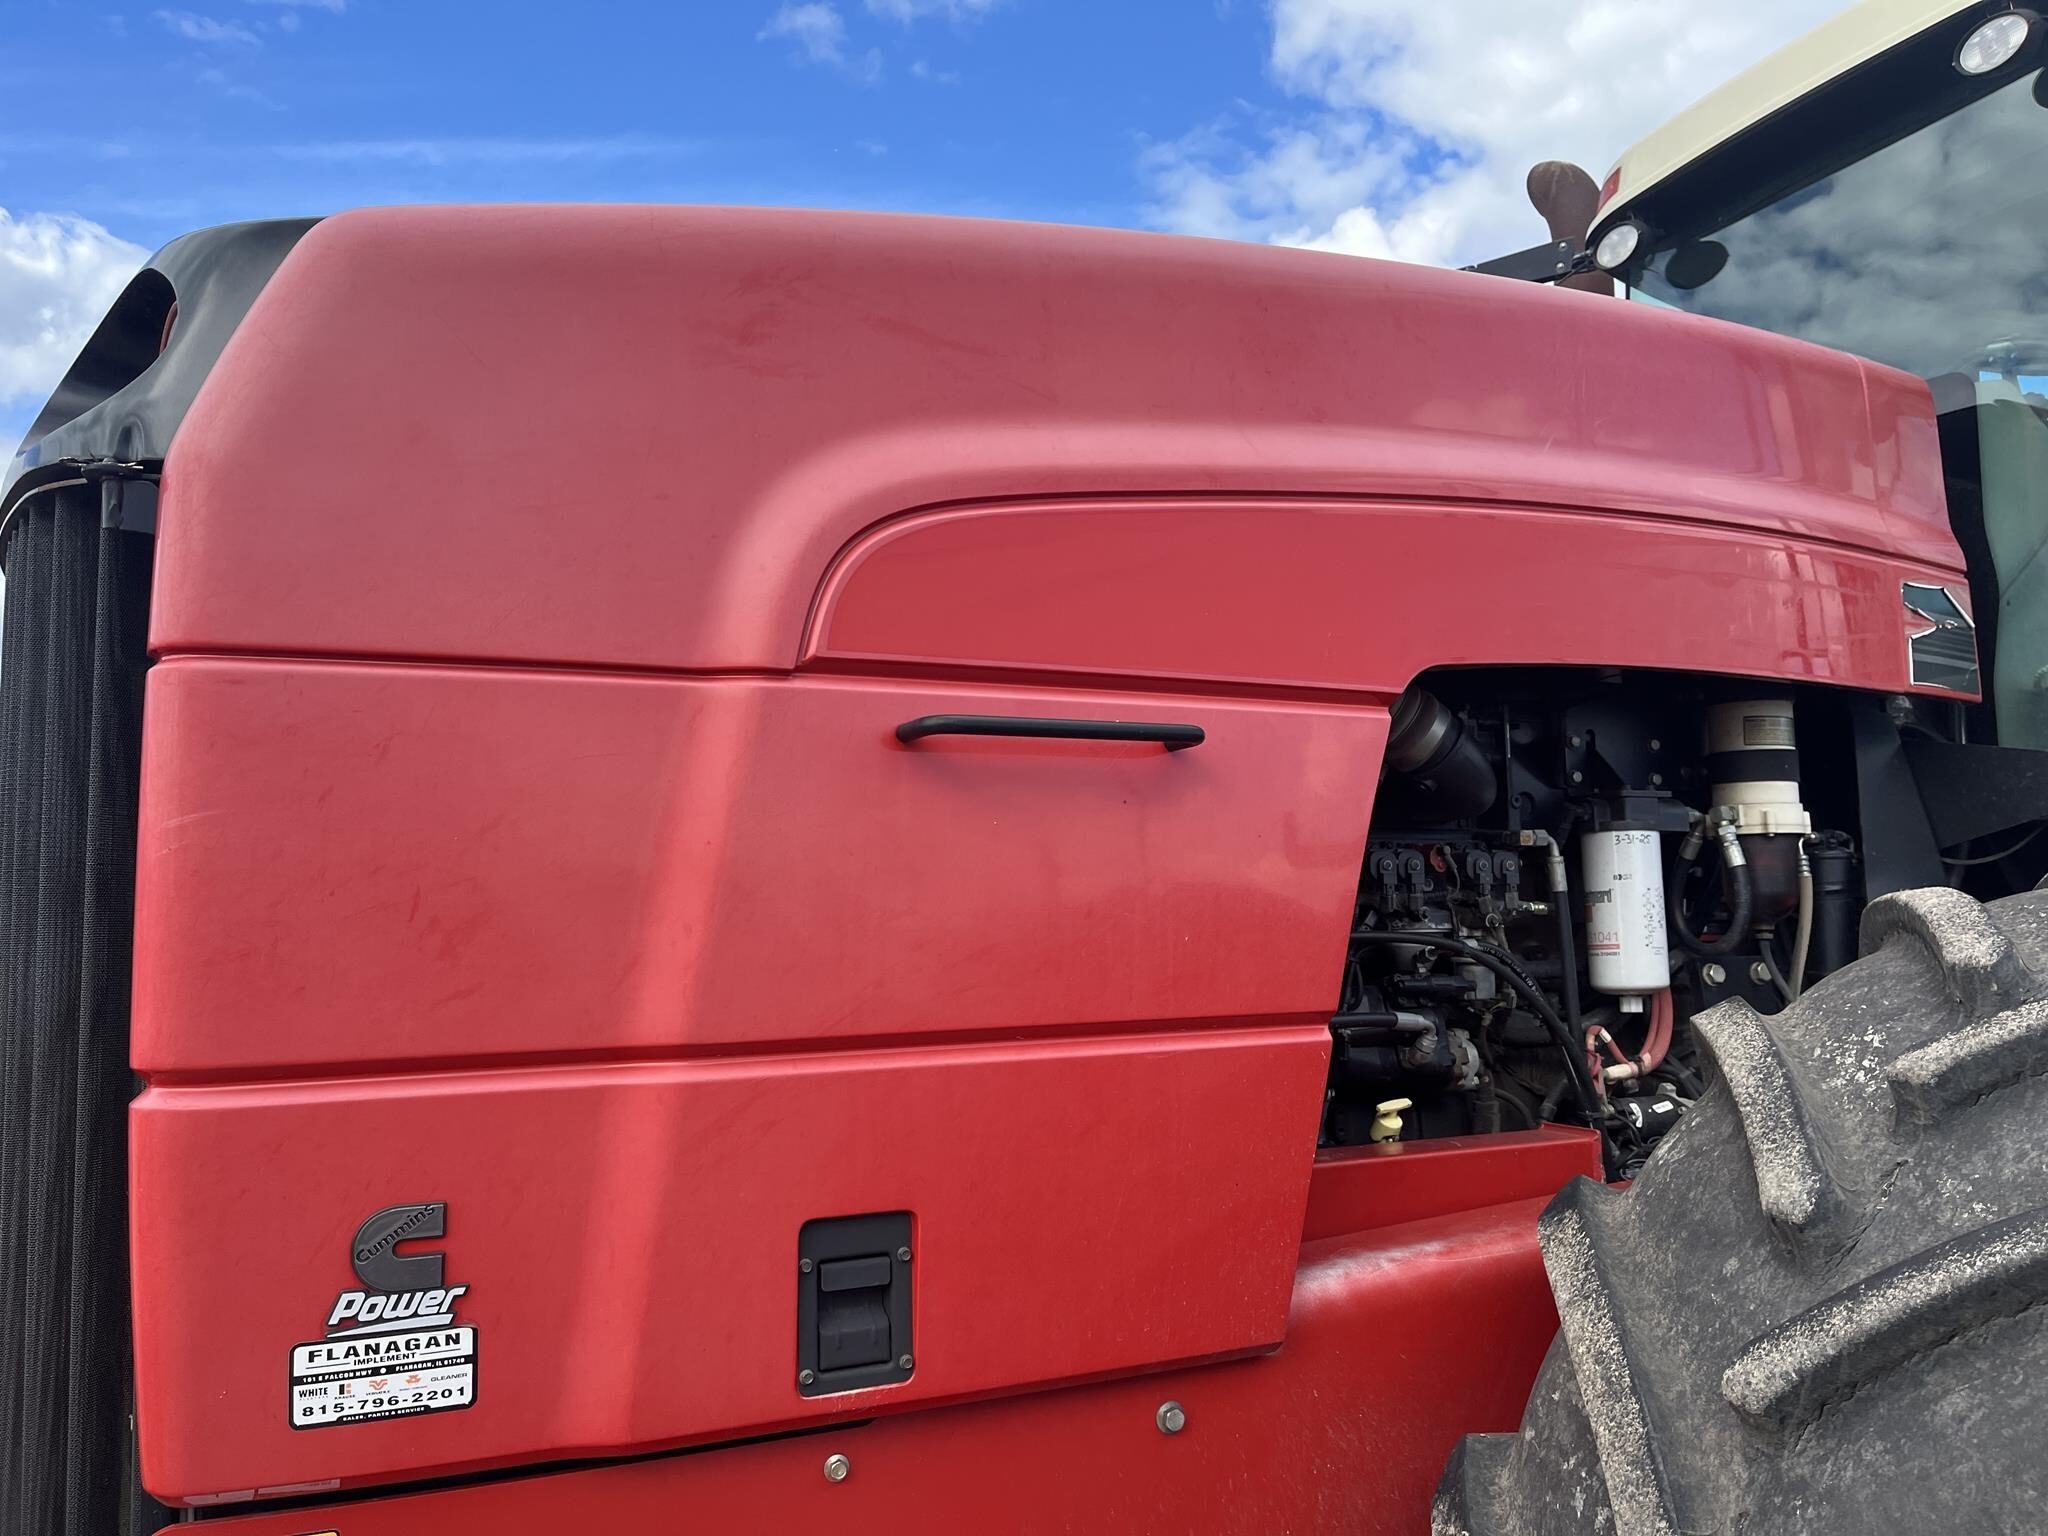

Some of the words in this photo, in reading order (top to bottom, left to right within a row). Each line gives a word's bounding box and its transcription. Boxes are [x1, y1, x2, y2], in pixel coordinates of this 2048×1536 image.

[355, 1205, 435, 1264] Cummins
[327, 1286, 467, 1325] Power
[308, 1333, 461, 1363] FLANAGAN
[353, 1352, 417, 1366] IMPLEMENT
[324, 1372, 354, 1380] FALCON
[430, 1372, 468, 1382] GLEANER
[298, 1387, 329, 1398] WHITE
[302, 1386, 466, 1417] 815-796-2201
